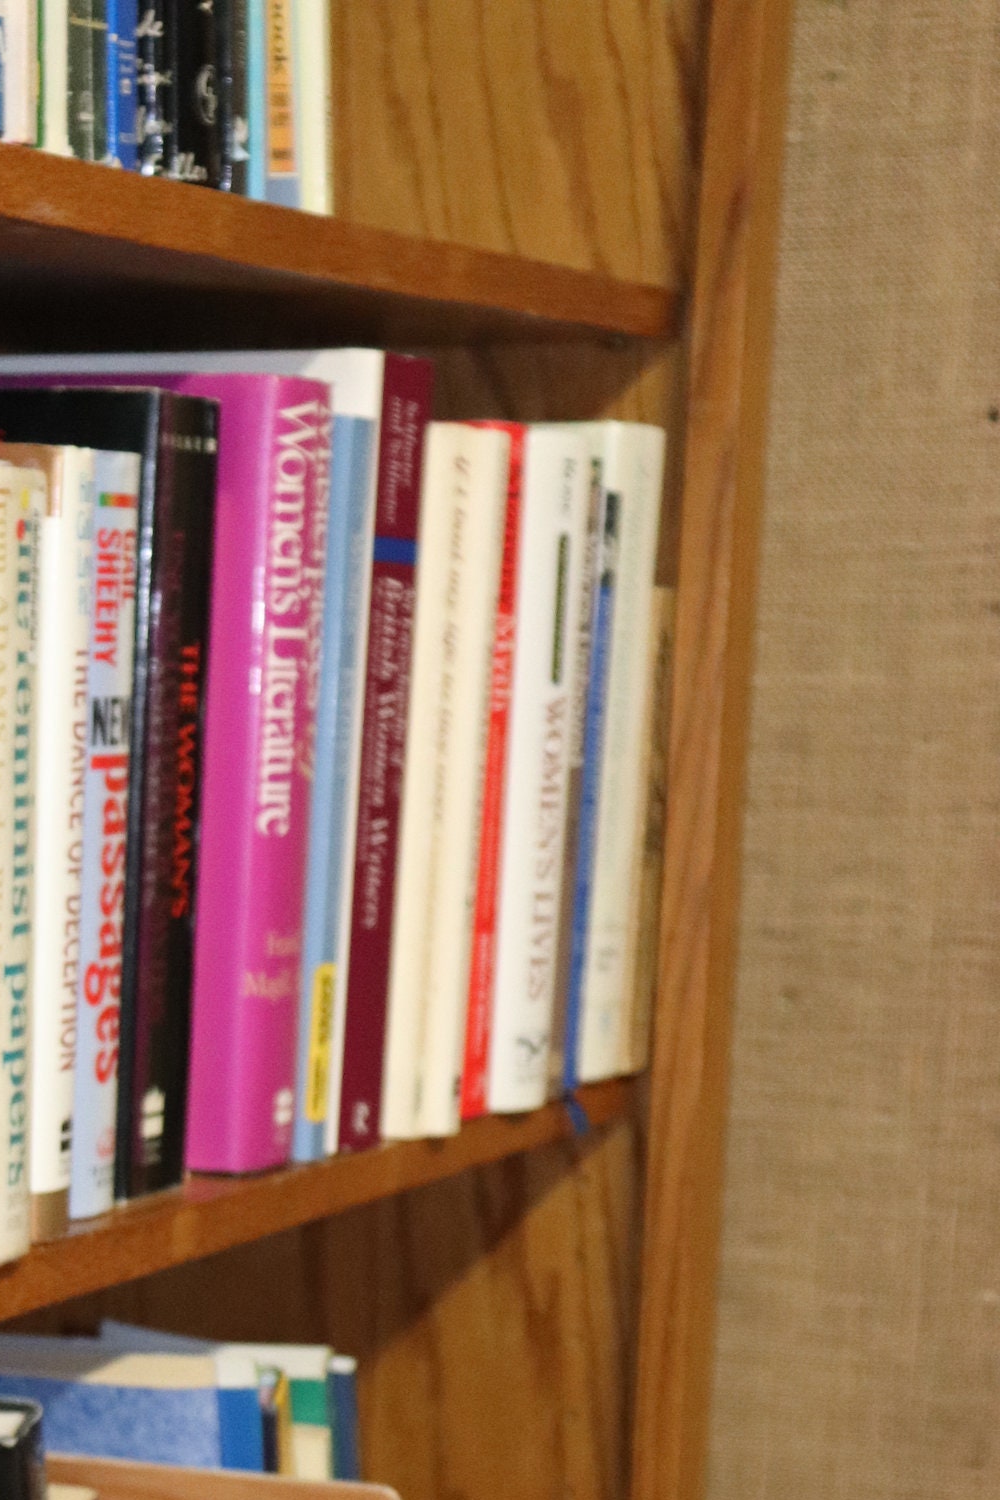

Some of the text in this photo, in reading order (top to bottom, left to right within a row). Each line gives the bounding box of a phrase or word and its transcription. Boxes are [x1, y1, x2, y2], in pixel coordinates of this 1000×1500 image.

[93, 529, 123, 667] SHEEHY
[256, 401, 319, 837] Women's Literature
[84, 754, 132, 1084] passages
[3, 962, 31, 1188] papers
